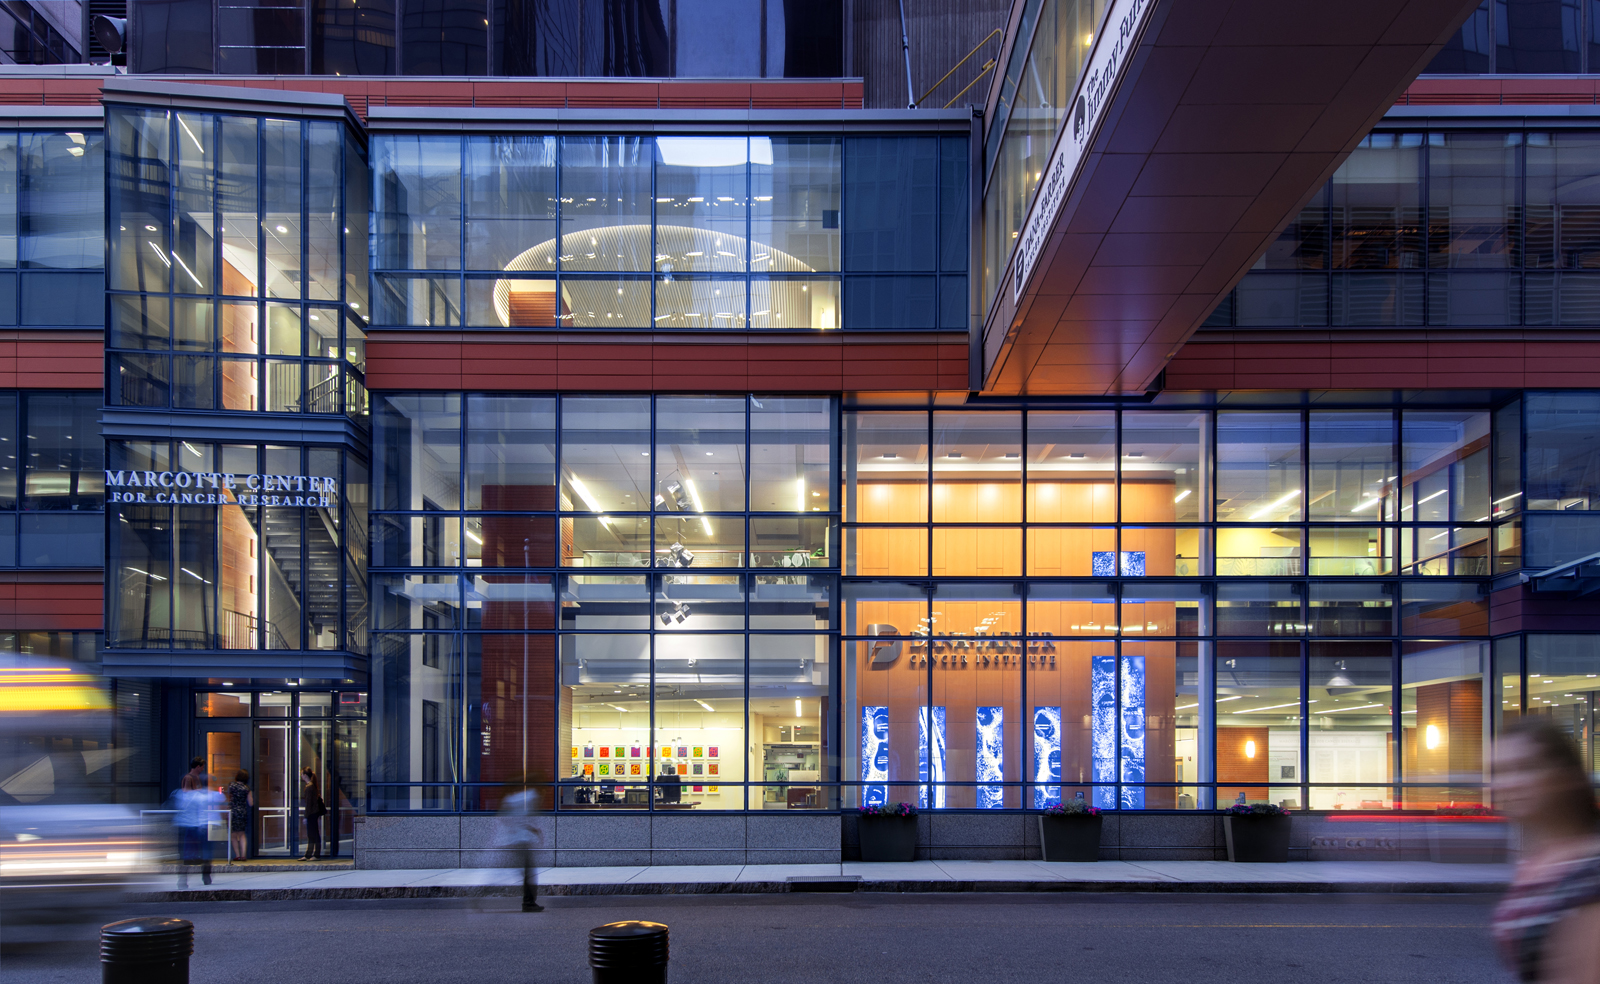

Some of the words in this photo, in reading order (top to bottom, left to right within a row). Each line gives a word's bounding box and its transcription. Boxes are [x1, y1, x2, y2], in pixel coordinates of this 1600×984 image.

[1087, 40, 1119, 135] Jimmy
[1119, 0, 1144, 54] Fun
[1087, 68, 1099, 99] The
[1025, 152, 1066, 258] DANA-FARBER
[105, 469, 237, 489] MARCOTTE
[246, 474, 337, 493] CENTER
[112, 491, 147, 503] FOR
[155, 492, 228, 504] CANCER
[237, 494, 330, 507] RESEARCH
[910, 631, 1056, 649] DNA-FARER
[910, 655, 968, 663] CANCER
[976, 655, 1056, 663] INSTIUTE
